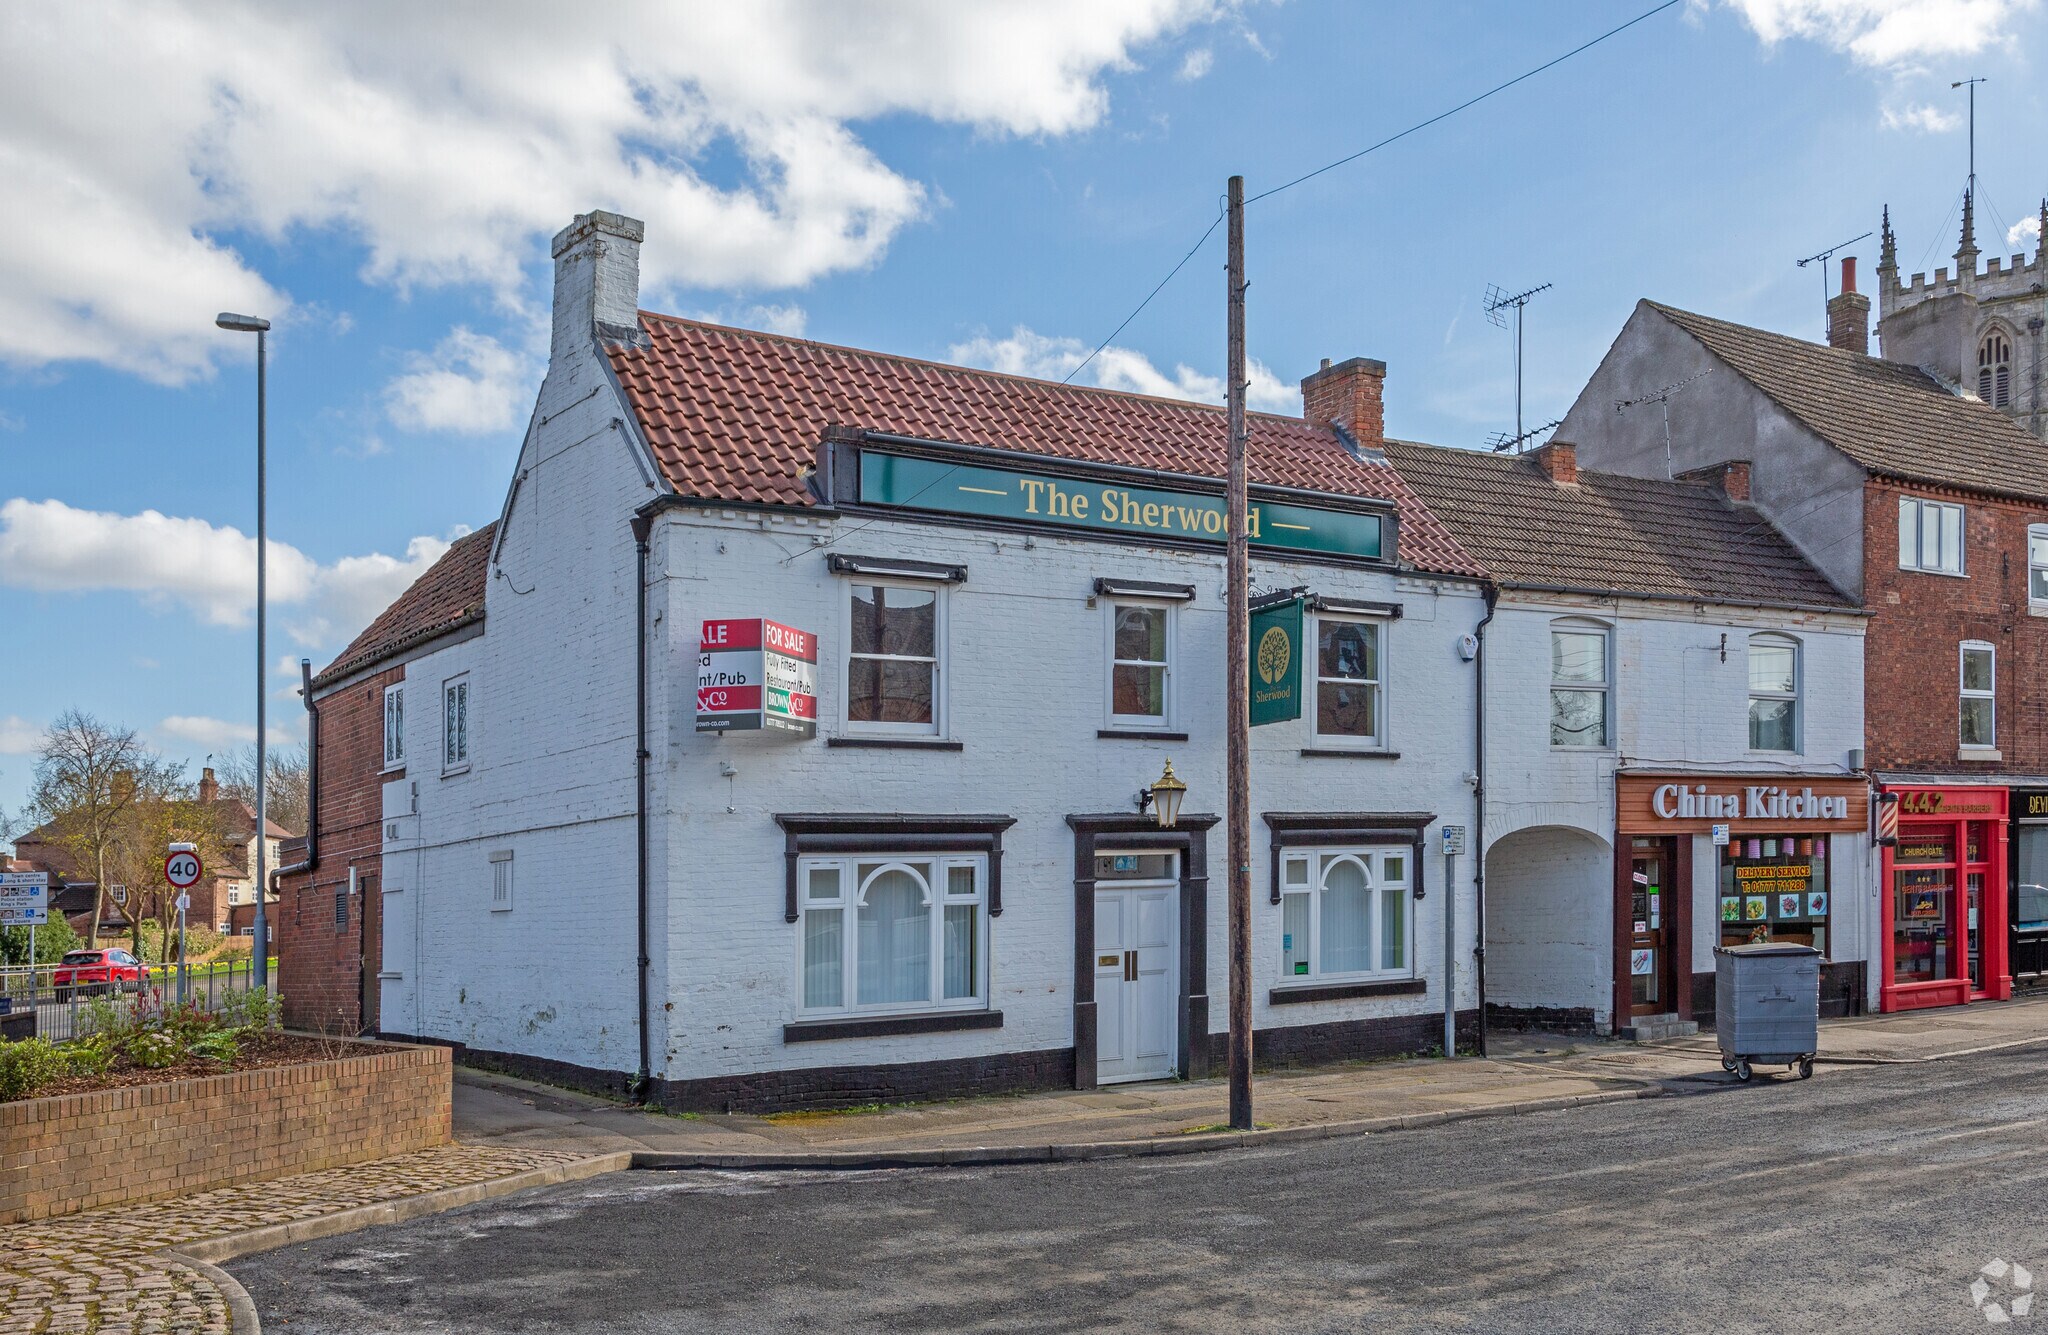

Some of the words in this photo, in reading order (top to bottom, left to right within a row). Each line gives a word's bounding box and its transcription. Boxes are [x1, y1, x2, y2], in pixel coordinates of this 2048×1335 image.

[1020, 479, 1089, 519] The
[1101, 489, 1261, 537] Sherwod
[766, 624, 782, 647] FOR
[784, 630, 804, 653] SALE
[767, 652, 780, 671] Fully
[780, 656, 797, 672] Fitted
[699, 671, 747, 686] nt/Pub
[767, 672, 811, 694] Restaurant/Pub
[1256, 685, 1291, 703] Sherwood
[1652, 784, 1741, 819] China
[1743, 786, 1848, 819] Kitchen
[1902, 791, 1944, 813] 4.4.2
[1904, 848, 1928, 856] CHURCH
[1928, 847, 1943, 855] GATE
[170, 861, 197, 877] 40
[1736, 866, 1776, 878] DELIVERY
[1777, 865, 1810, 877] SERVICE
[1742, 881, 1750, 893] T:
[1751, 880, 1776, 892] 01777
[1777, 880, 1805, 891] 711288
